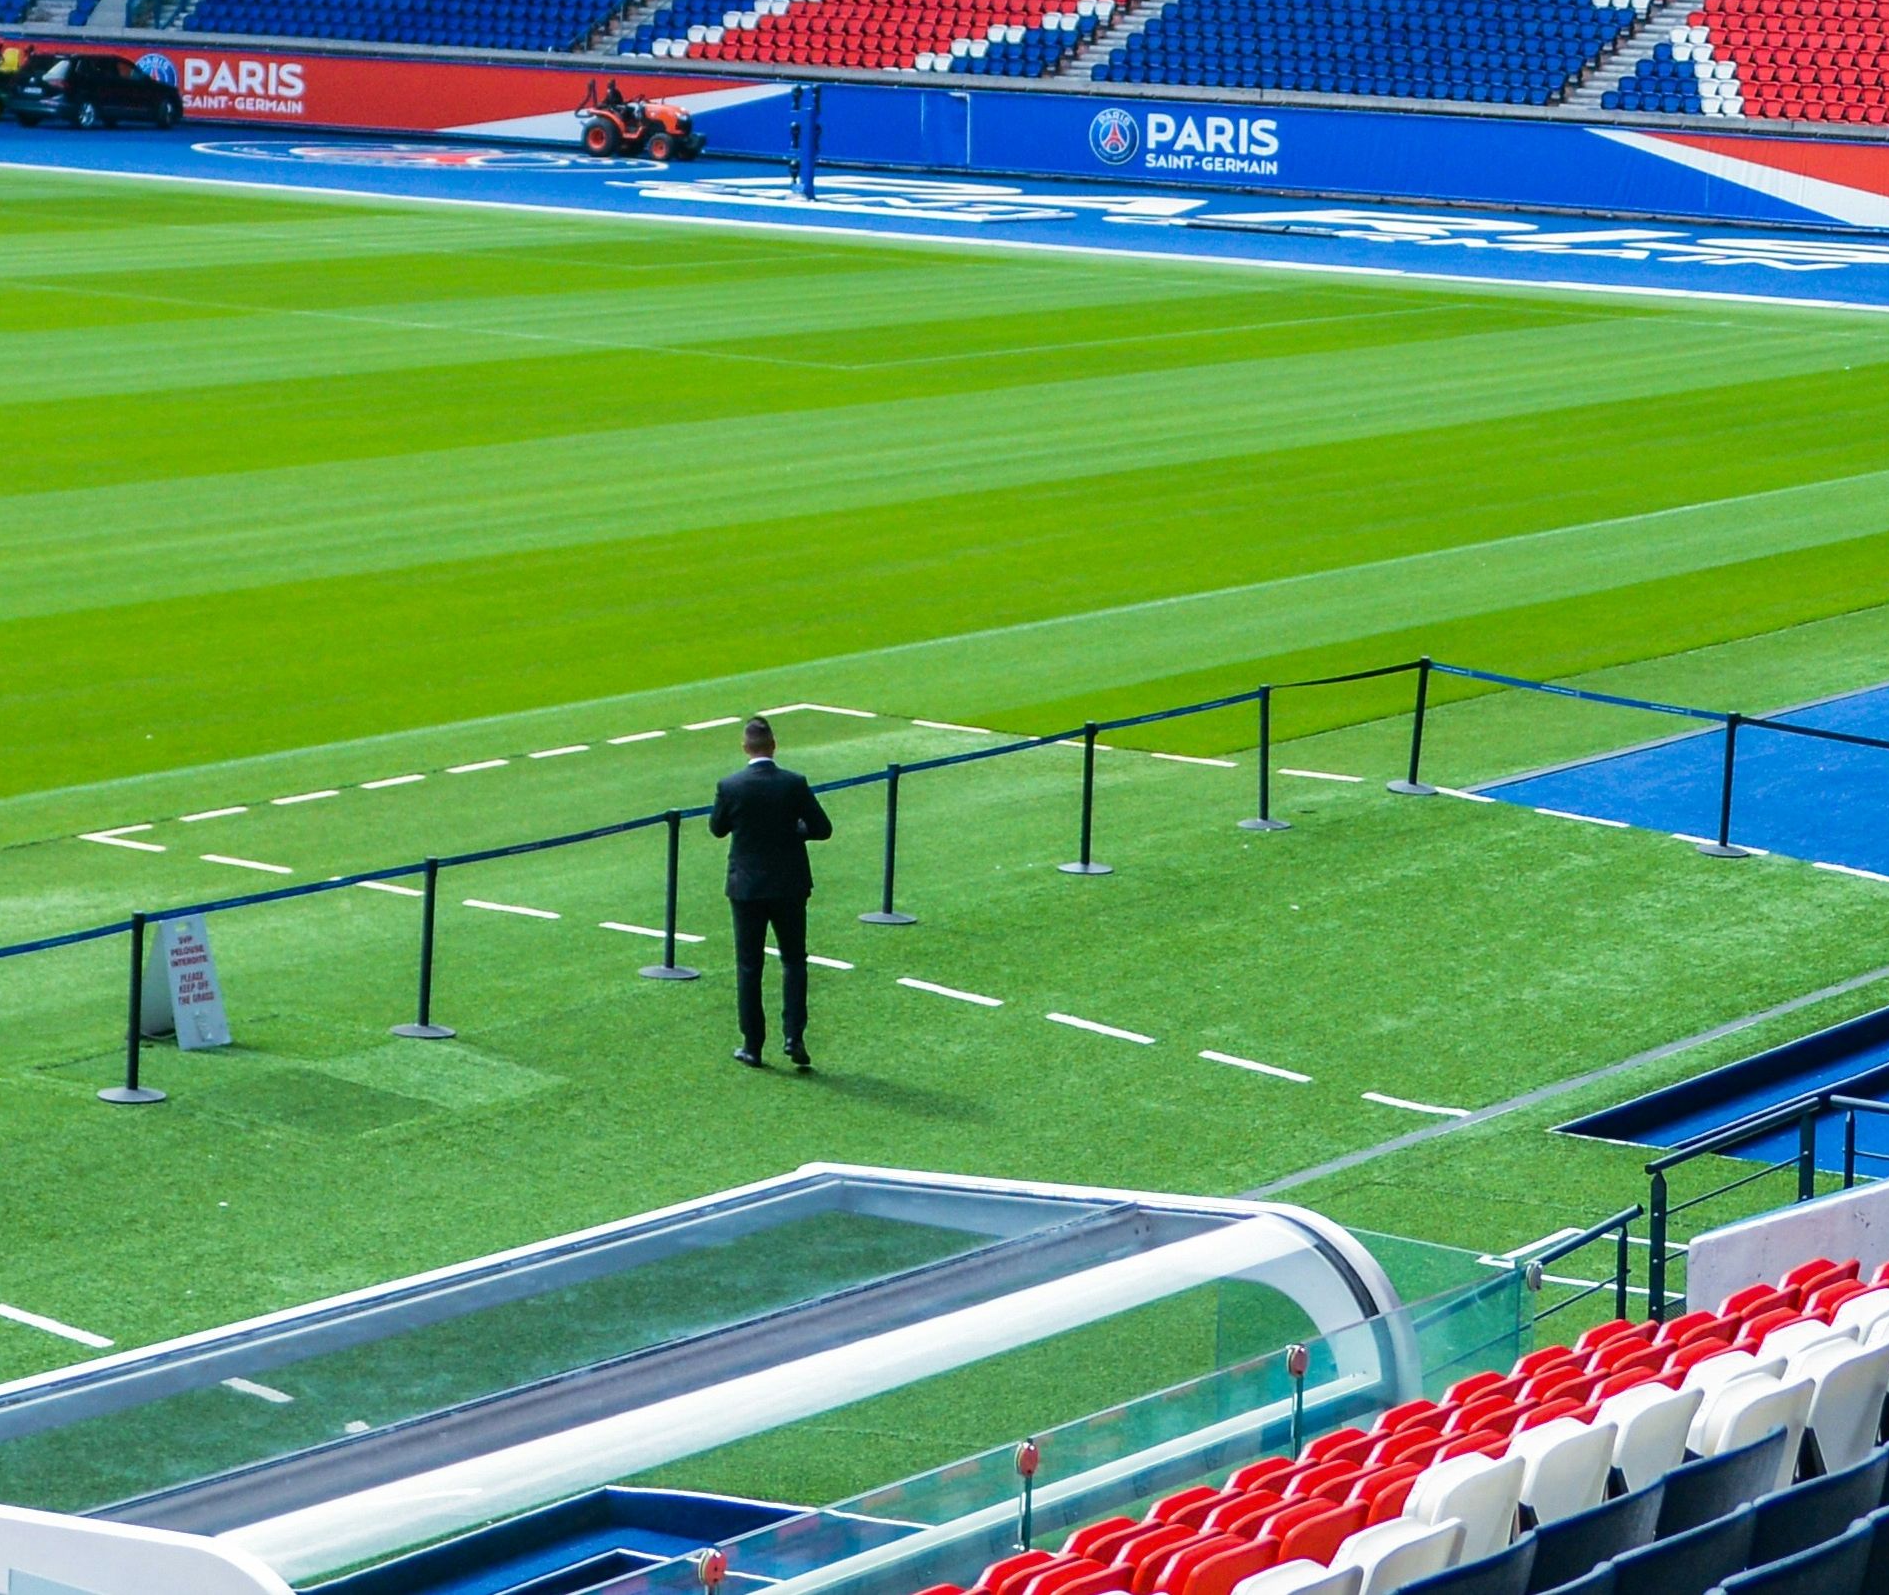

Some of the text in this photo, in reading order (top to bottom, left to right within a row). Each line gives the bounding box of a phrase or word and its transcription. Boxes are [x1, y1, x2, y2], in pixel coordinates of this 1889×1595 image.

[183, 58, 305, 97] PARIS
[182, 94, 303, 114] SAINT-GERMAIN
[1097, 110, 1131, 127] PARIS
[1147, 113, 1279, 156] PARIS
[1145, 153, 1278, 175] SAINT-GERMAIN
[180, 971, 204, 983] PLEASE
[178, 983, 196, 994] KEEP
